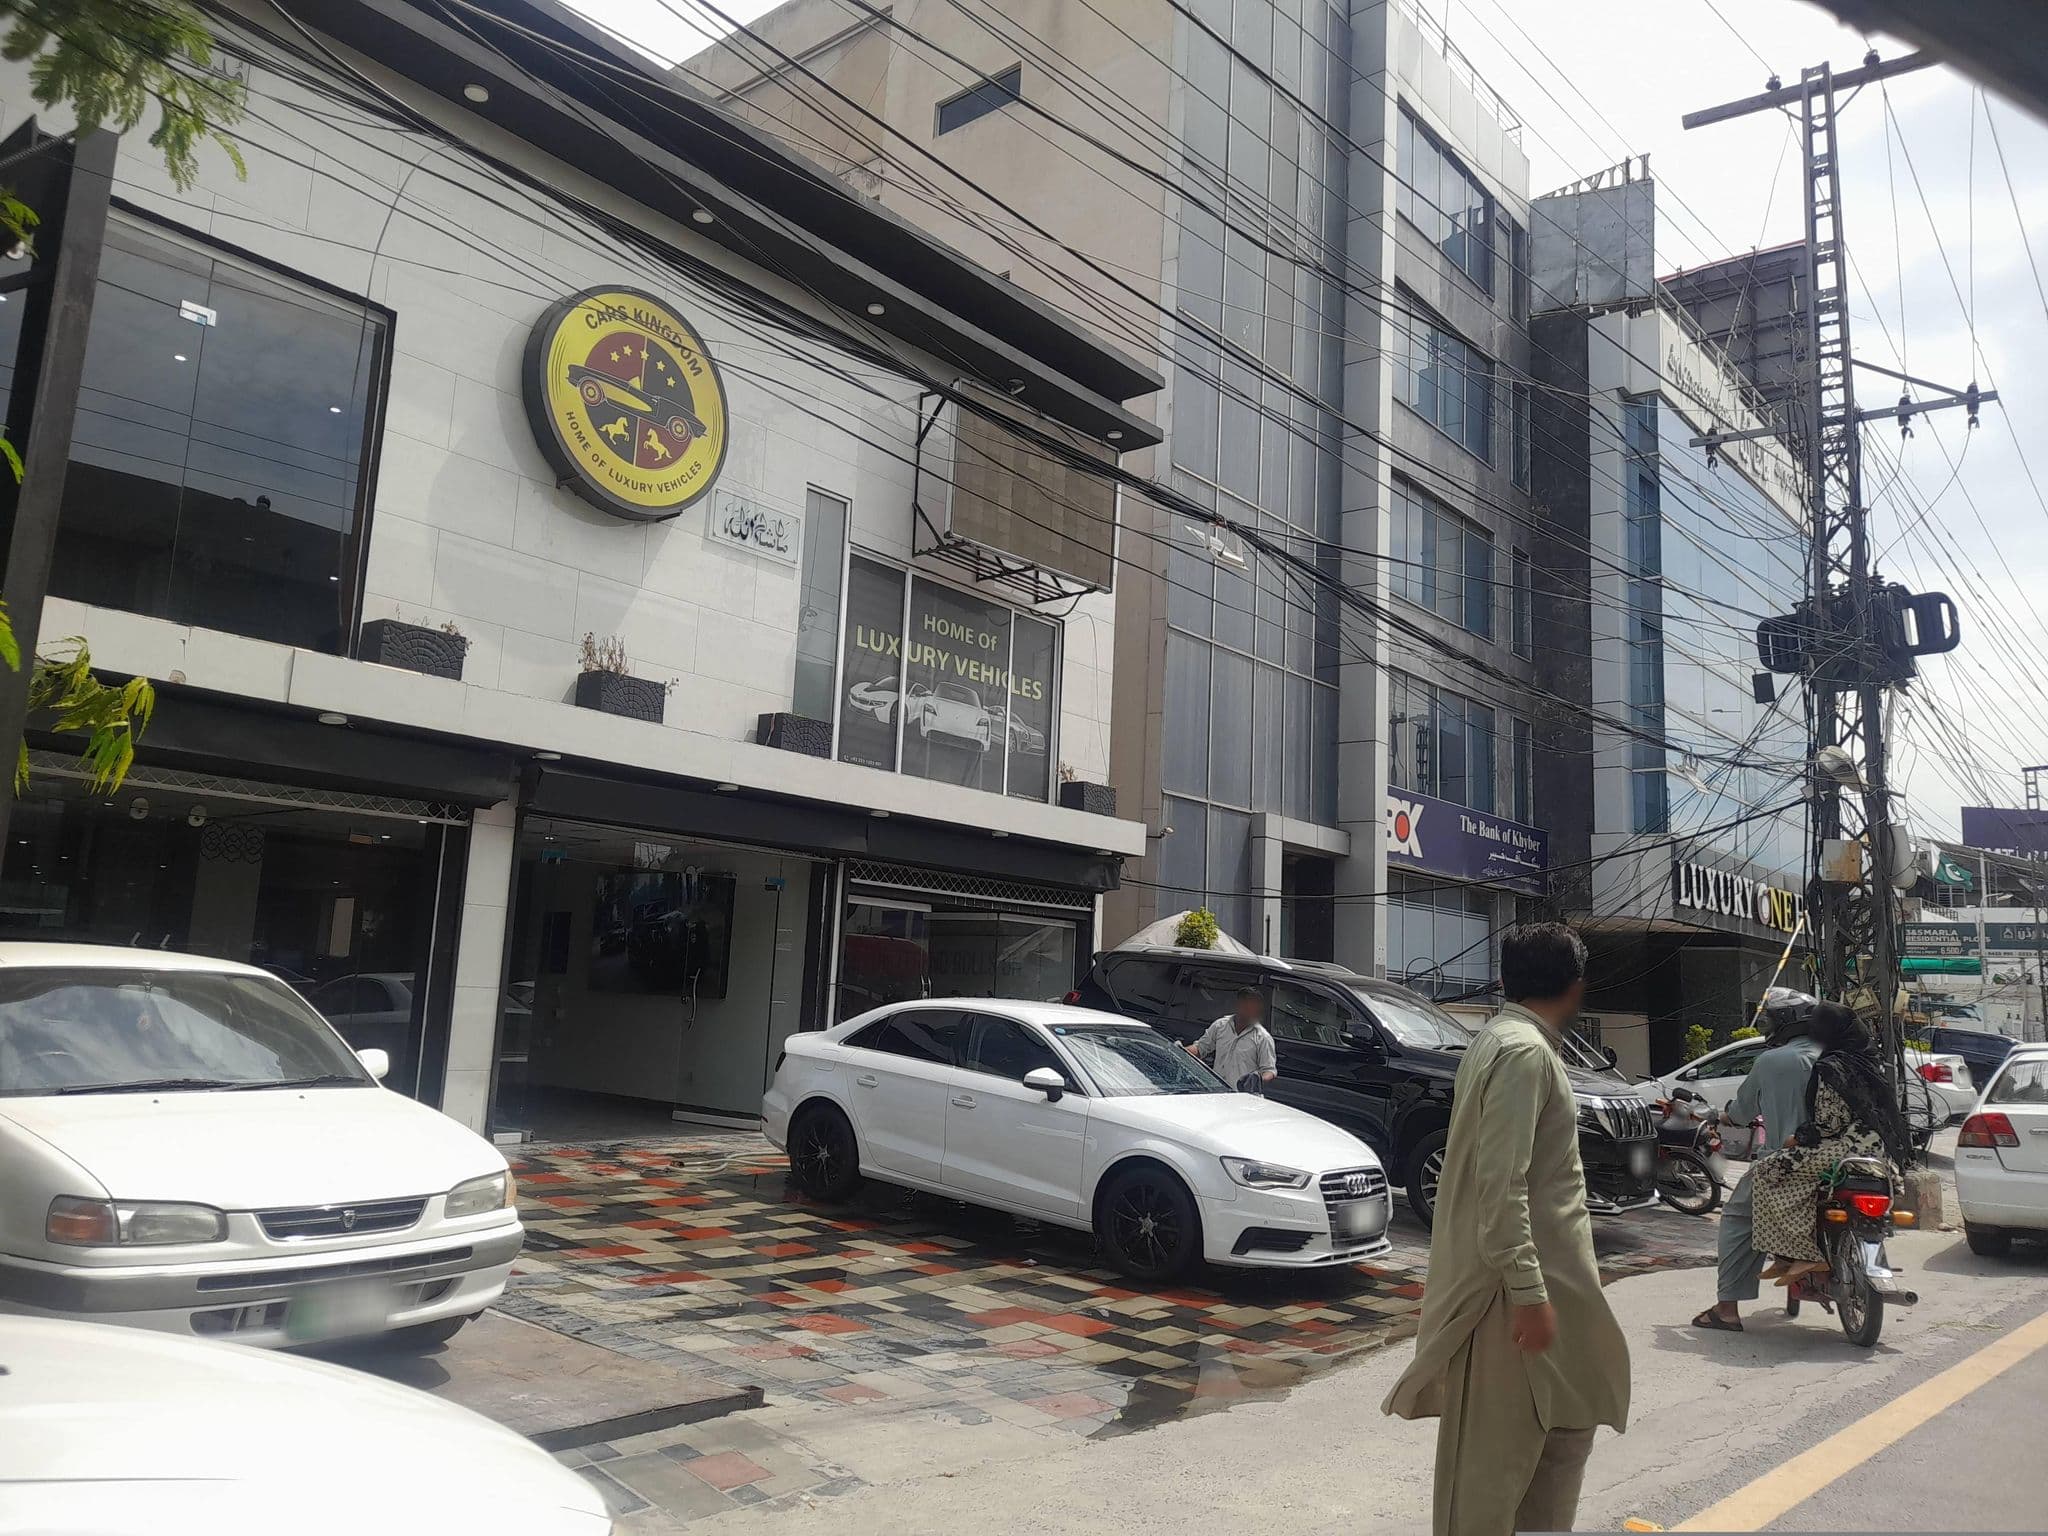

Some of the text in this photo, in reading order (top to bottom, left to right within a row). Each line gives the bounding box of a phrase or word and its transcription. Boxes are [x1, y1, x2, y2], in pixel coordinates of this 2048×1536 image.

[585, 304, 703, 378] CARS KINGDOM
[565, 411, 703, 494] HOME OF LUXURY VEHICLES
[855, 624, 1044, 701] LUXURY VEHICLES
[923, 614, 974, 645] HOME
[1460, 814, 1541, 853] The Bank of Khyber
[1679, 859, 1754, 919] LUXURY
